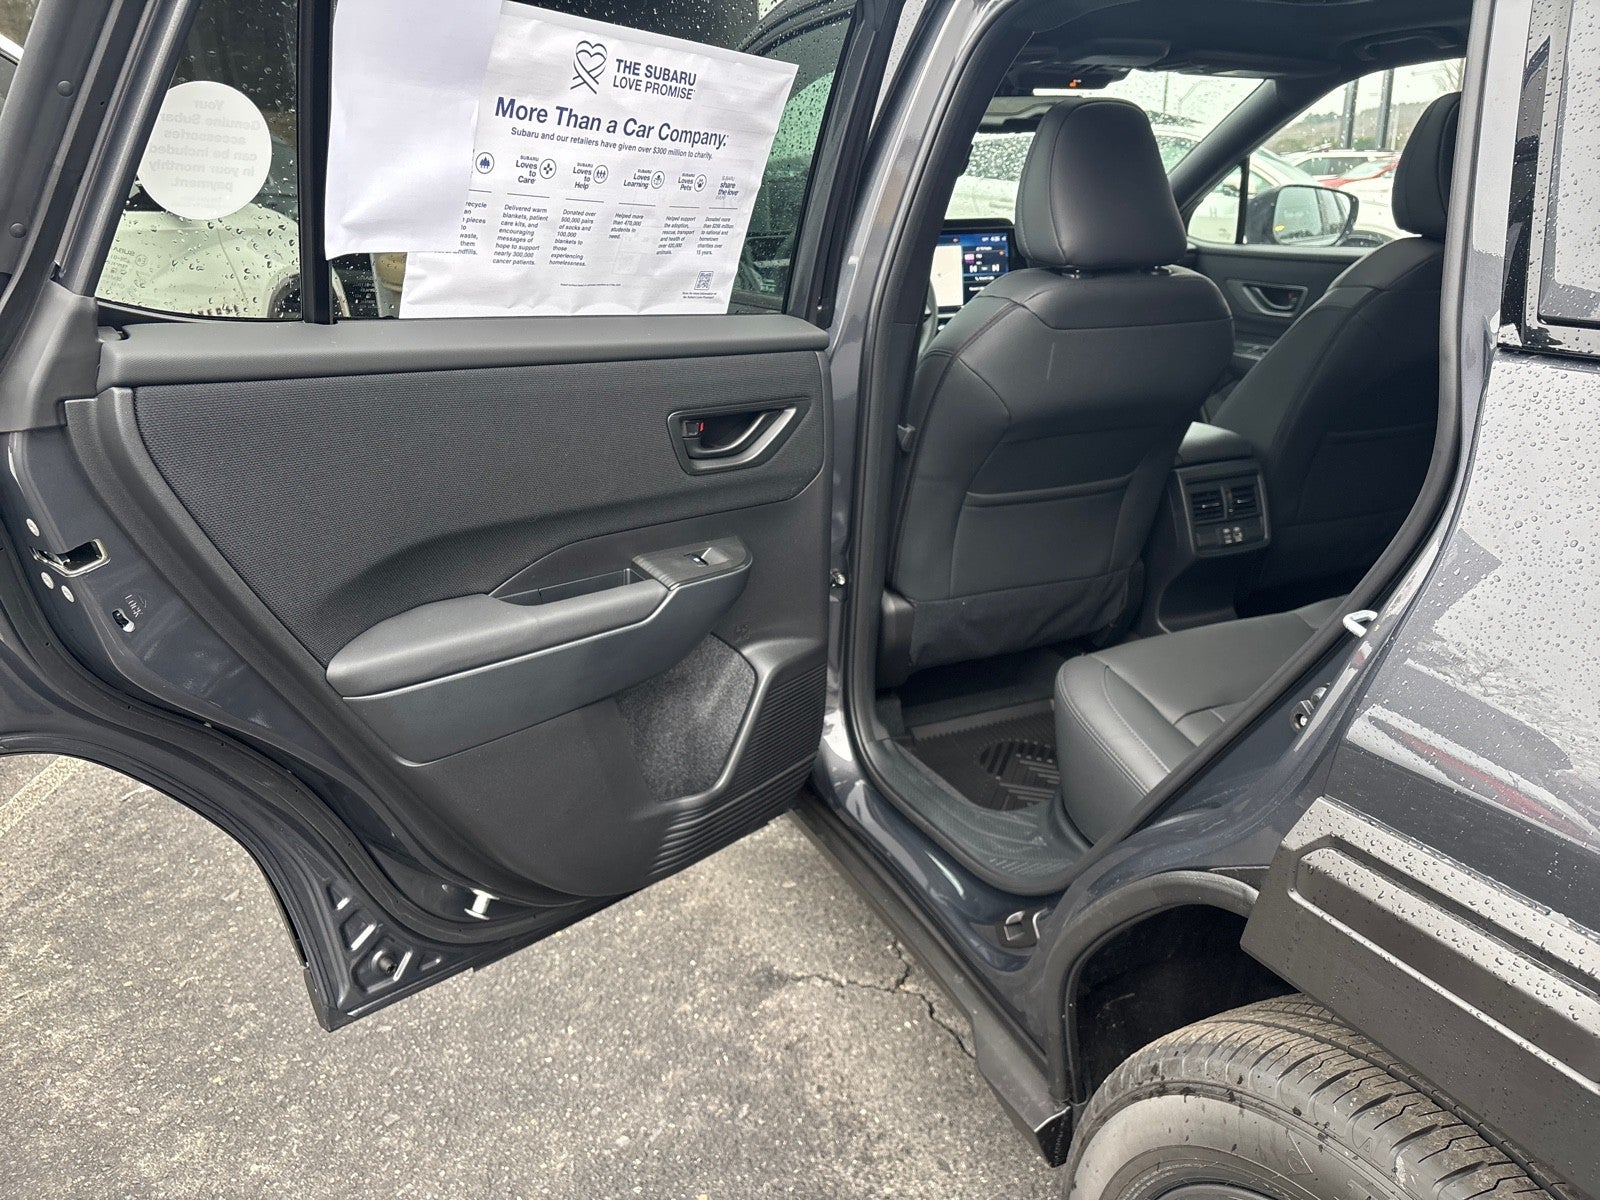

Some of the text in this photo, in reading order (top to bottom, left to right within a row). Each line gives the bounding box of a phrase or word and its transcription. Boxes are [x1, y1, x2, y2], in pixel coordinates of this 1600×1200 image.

[616, 58, 697, 86] THE SUBARU
[612, 75, 695, 100] LOVE PROMISE
[495, 96, 548, 124] More
[556, 106, 602, 132] Than
[606, 119, 618, 134] a
[623, 118, 655, 139] Car
[510, 126, 712, 160] Subaru and our retailers have given over $300 million to charity.
[516, 160, 538, 170] Loves
[572, 166, 592, 176] Loves
[518, 175, 535, 184] Care
[633, 173, 650, 181] Loves
[574, 182, 590, 190] Help
[623, 180, 649, 190] Learning
[680, 184, 692, 192] Pets
[718, 188, 728, 196] the
[504, 204, 532, 212] Delivered
[498, 228, 534, 236] encouraging
[124, 594, 143, 618] LOCK
